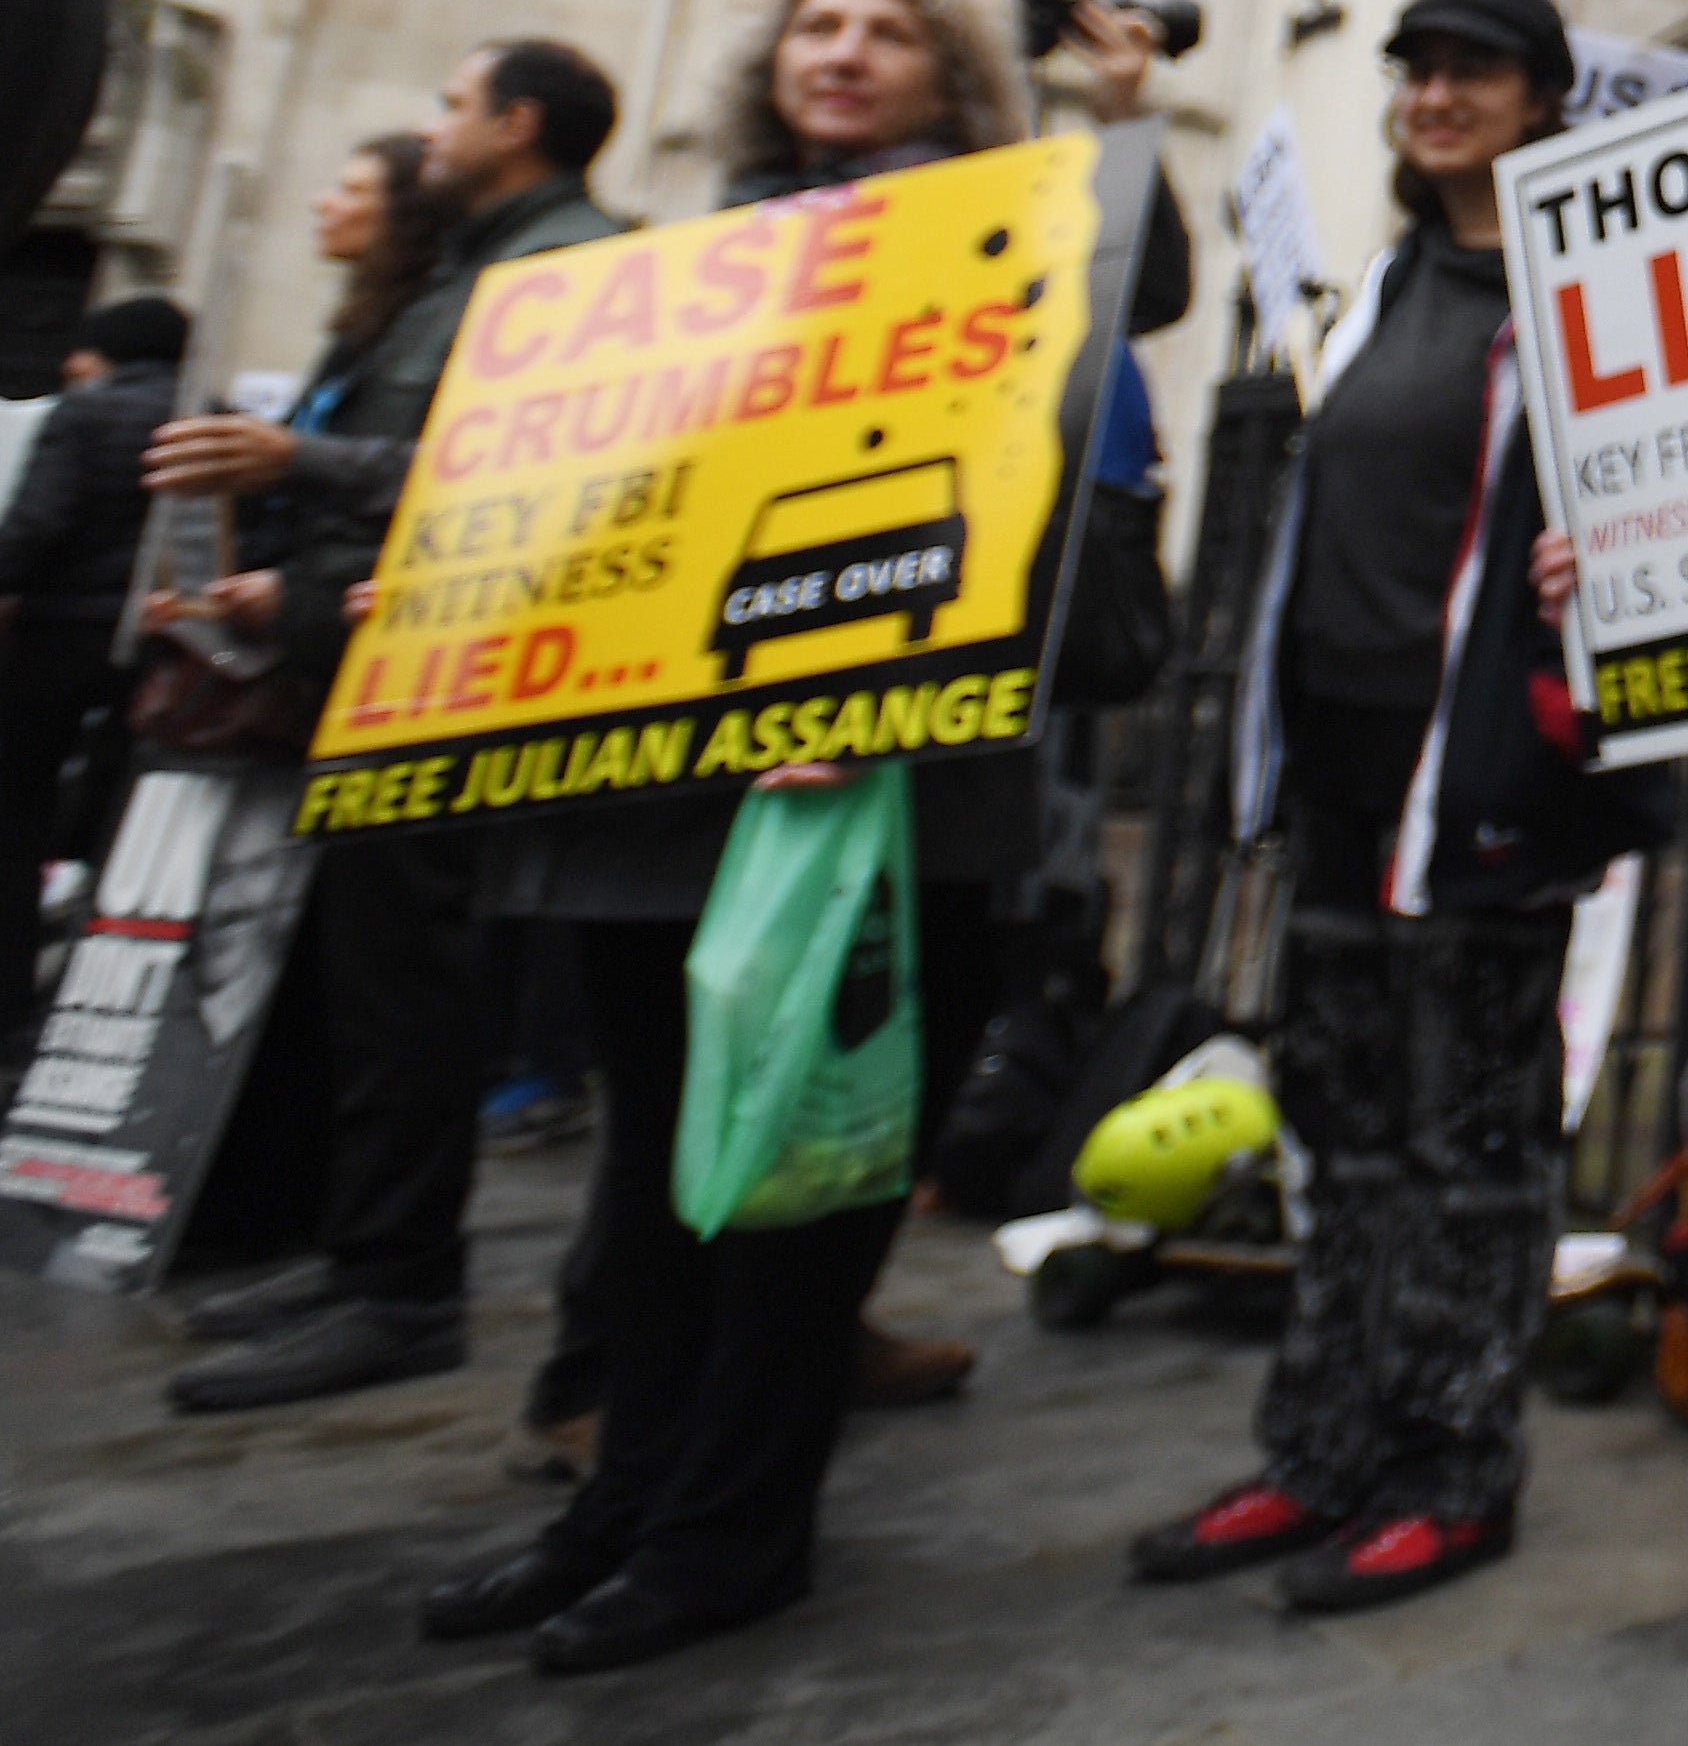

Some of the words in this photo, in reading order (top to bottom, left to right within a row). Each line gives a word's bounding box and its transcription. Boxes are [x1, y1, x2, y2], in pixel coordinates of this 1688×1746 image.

[477, 197, 888, 380] CASE
[435, 304, 1020, 481] CRUMBLES
[402, 491, 540, 569] KEY
[574, 461, 692, 533] FBI
[1573, 439, 1652, 499] KEY
[387, 538, 672, 628] WITNESS
[724, 571, 830, 625] CASE
[834, 545, 953, 601] OVER
[1590, 565, 1666, 624] U.S.
[350, 628, 656, 726] LIED...
[296, 757, 450, 835] FREE
[453, 719, 691, 811] JULIAN
[696, 670, 1034, 774] ASSANGE
